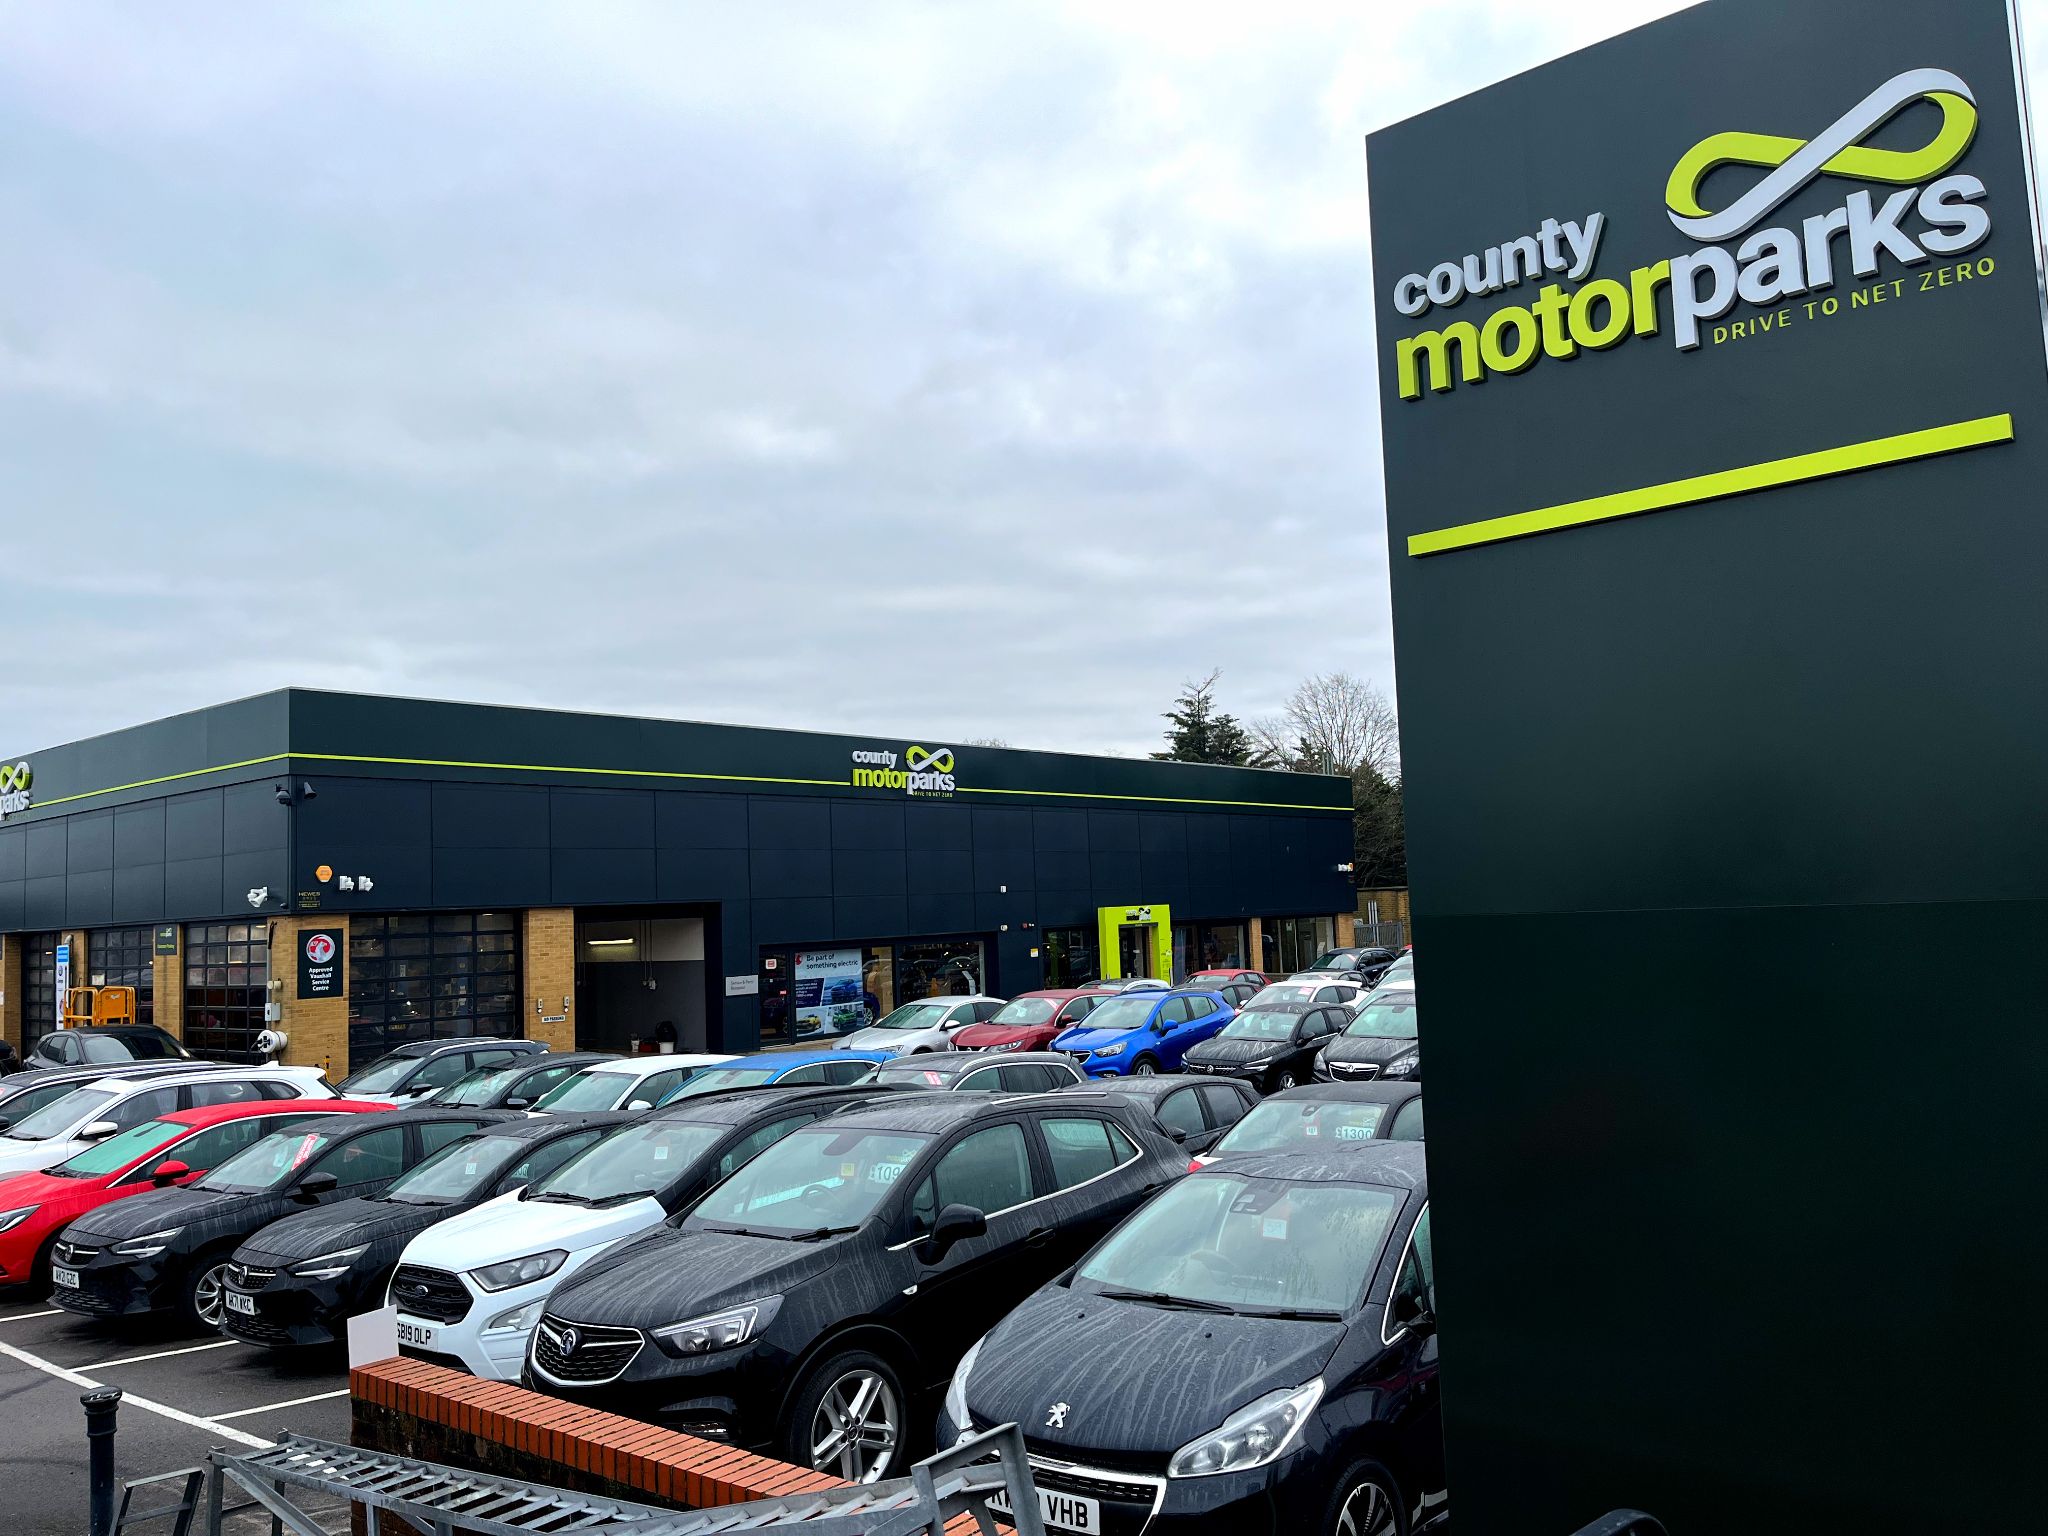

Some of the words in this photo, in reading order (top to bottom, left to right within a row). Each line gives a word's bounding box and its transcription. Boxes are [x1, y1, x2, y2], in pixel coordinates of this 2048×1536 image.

[1394, 211, 1605, 317] county
[1713, 308, 1792, 345] DRIVE
[1803, 296, 1839, 321] TO
[1851, 278, 1905, 309] NET
[1918, 257, 1996, 293] ZERO
[852, 750, 898, 769] county
[806, 961, 837, 970] something
[838, 958, 859, 967] electric
[815, 953, 828, 963] part
[828, 952, 835, 961] of
[1046, 1494, 1089, 1528] VHB
